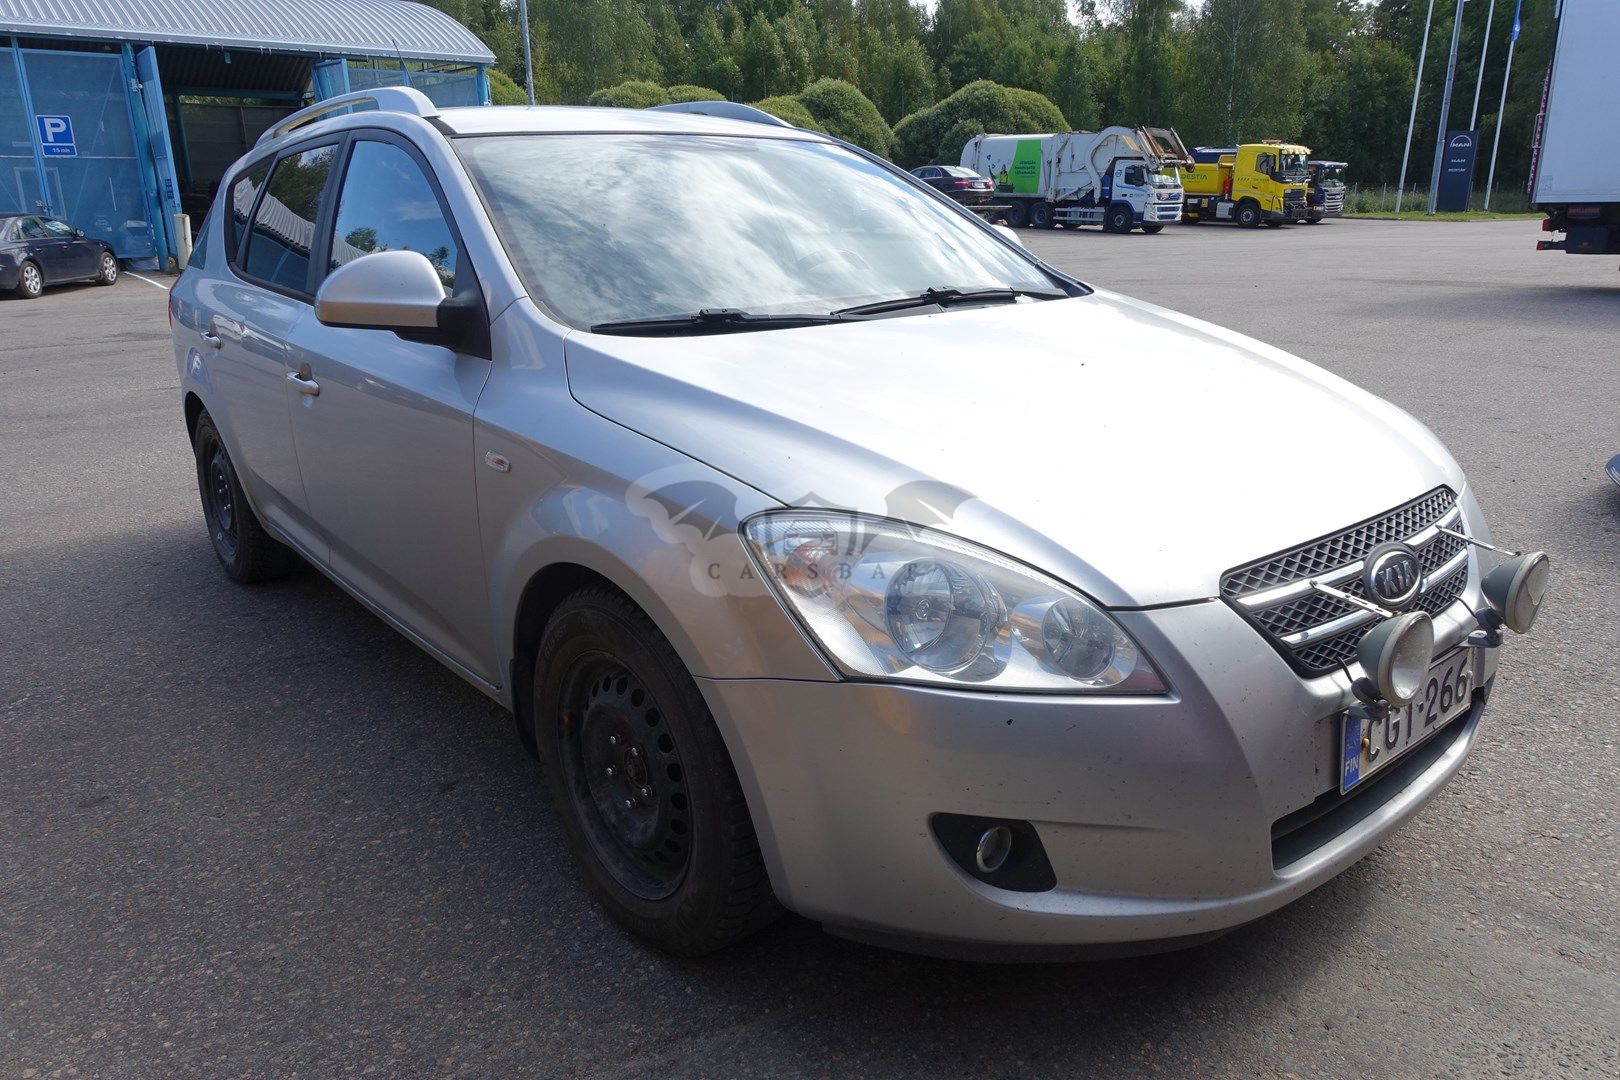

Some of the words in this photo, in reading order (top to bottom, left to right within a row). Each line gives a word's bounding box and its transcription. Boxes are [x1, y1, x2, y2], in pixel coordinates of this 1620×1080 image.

[44, 117, 67, 142] P
[1377, 559, 1416, 597] KIA
[1344, 755, 1359, 776] FIN
